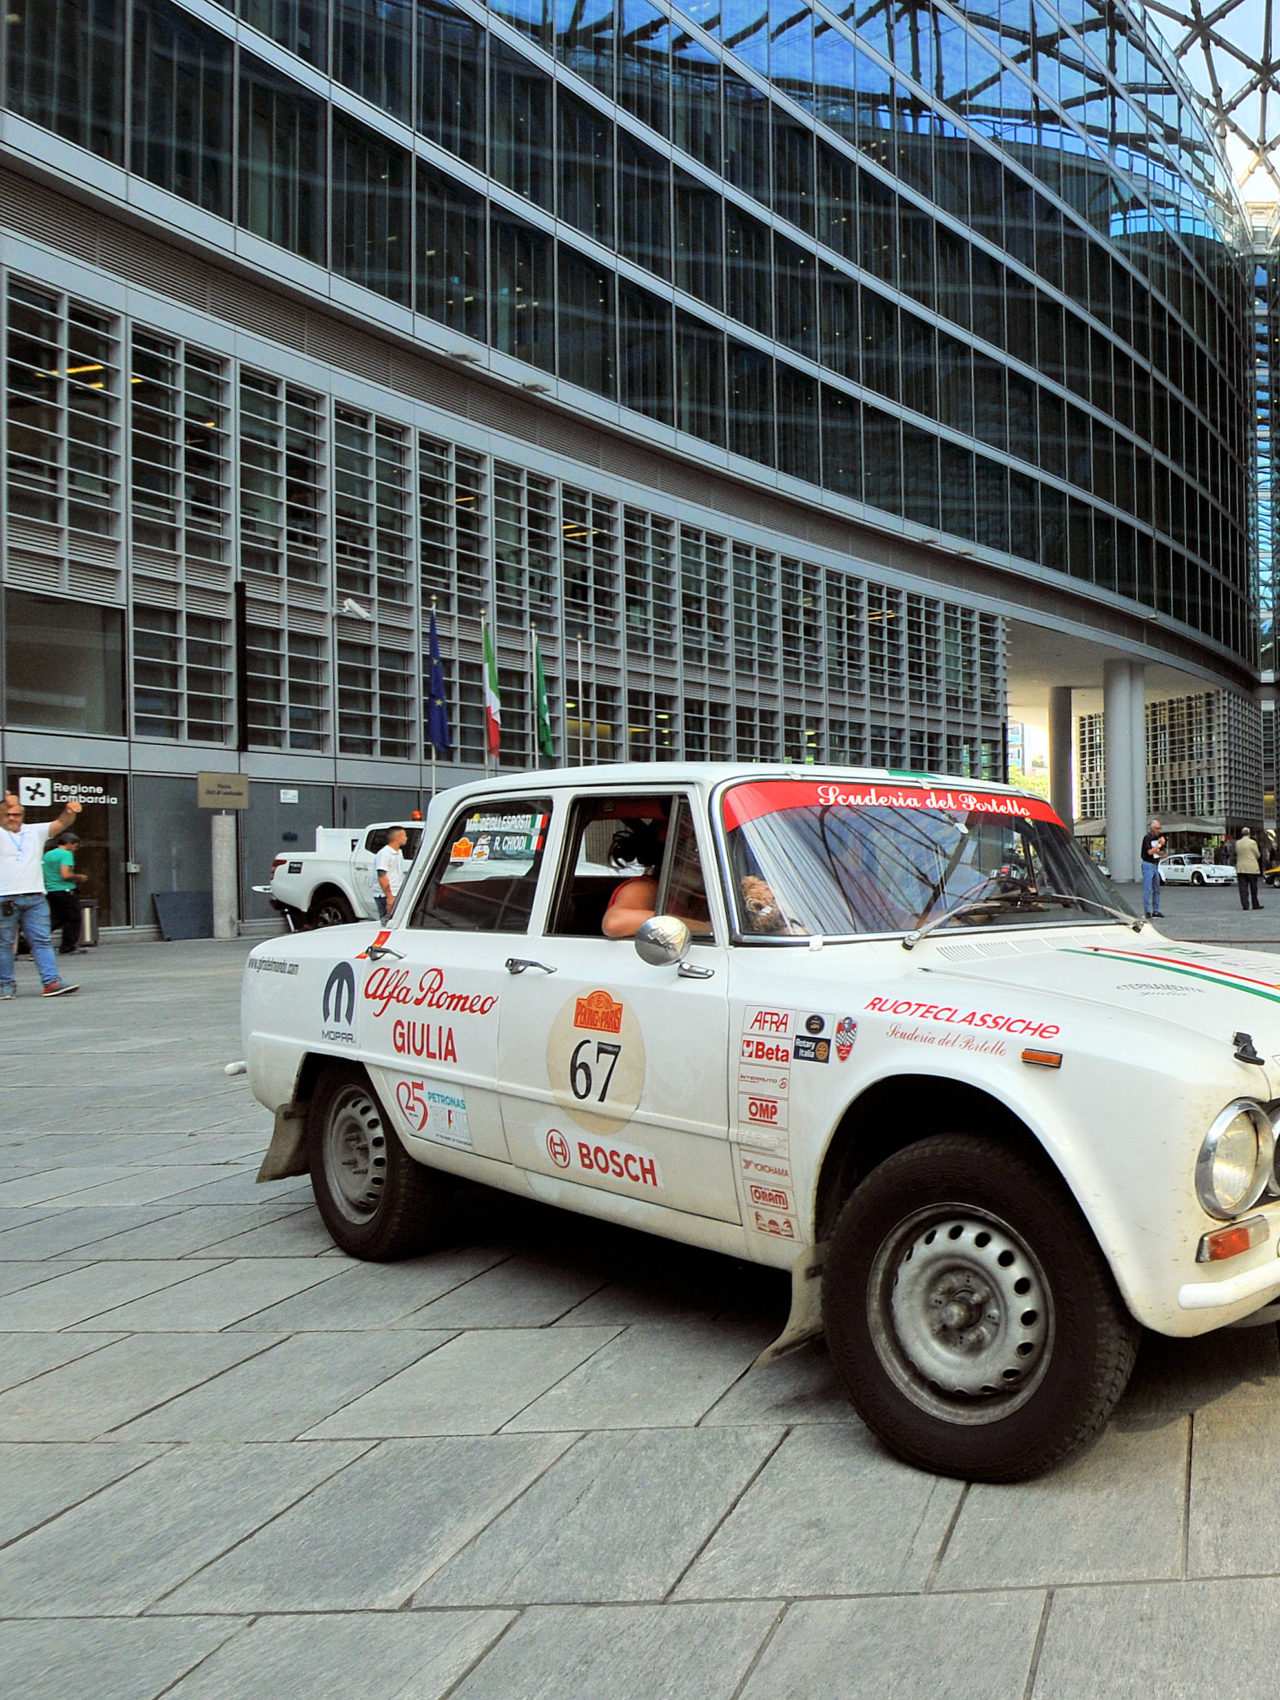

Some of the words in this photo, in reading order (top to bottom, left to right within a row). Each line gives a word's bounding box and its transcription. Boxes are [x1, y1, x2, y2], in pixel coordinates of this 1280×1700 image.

[53, 782, 104, 795] Regione
[53, 793, 118, 805] Lombardia
[816, 785, 922, 808] Scuderia
[925, 789, 957, 810] del
[958, 793, 1032, 816] Portello
[364, 967, 413, 1017] Alfa
[413, 967, 499, 1016] Romeo
[750, 1011, 789, 1033] AFRA
[321, 1029, 354, 1044] MOPAR
[393, 1019, 458, 1063] GIULIA
[886, 1022, 936, 1045] Scuderia
[937, 1034, 959, 1049] del
[959, 1034, 1008, 1057] Portello
[754, 1041, 790, 1063] Beta
[569, 1039, 622, 1103] 67
[427, 1091, 466, 1110] PETRONAS
[748, 1101, 778, 1120] OMP
[577, 1141, 658, 1188] BOSCH
